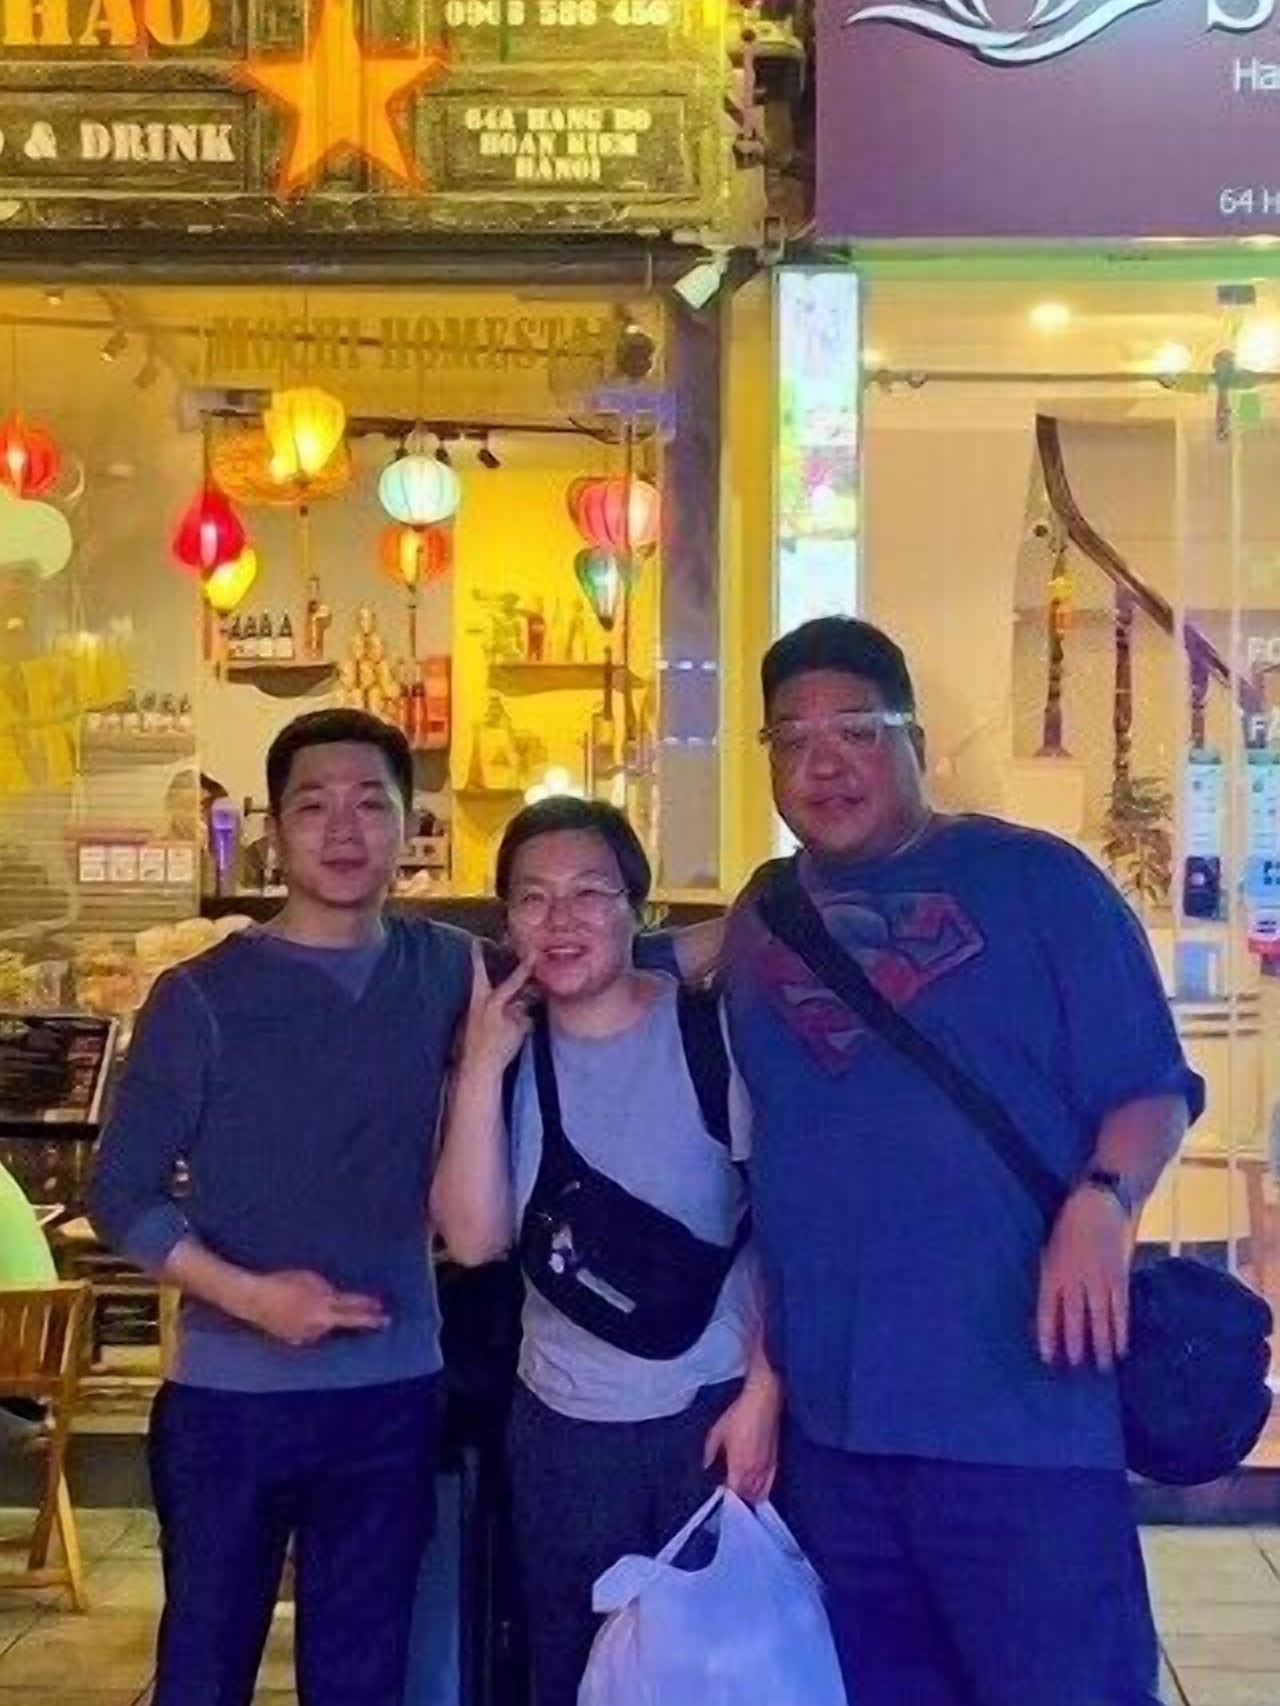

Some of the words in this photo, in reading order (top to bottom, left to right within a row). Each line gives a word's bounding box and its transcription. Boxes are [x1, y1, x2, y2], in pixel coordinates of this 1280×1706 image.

[23, 120, 58, 160] &
[80, 119, 237, 163] DRINK
[1219, 189, 1253, 214] 64
